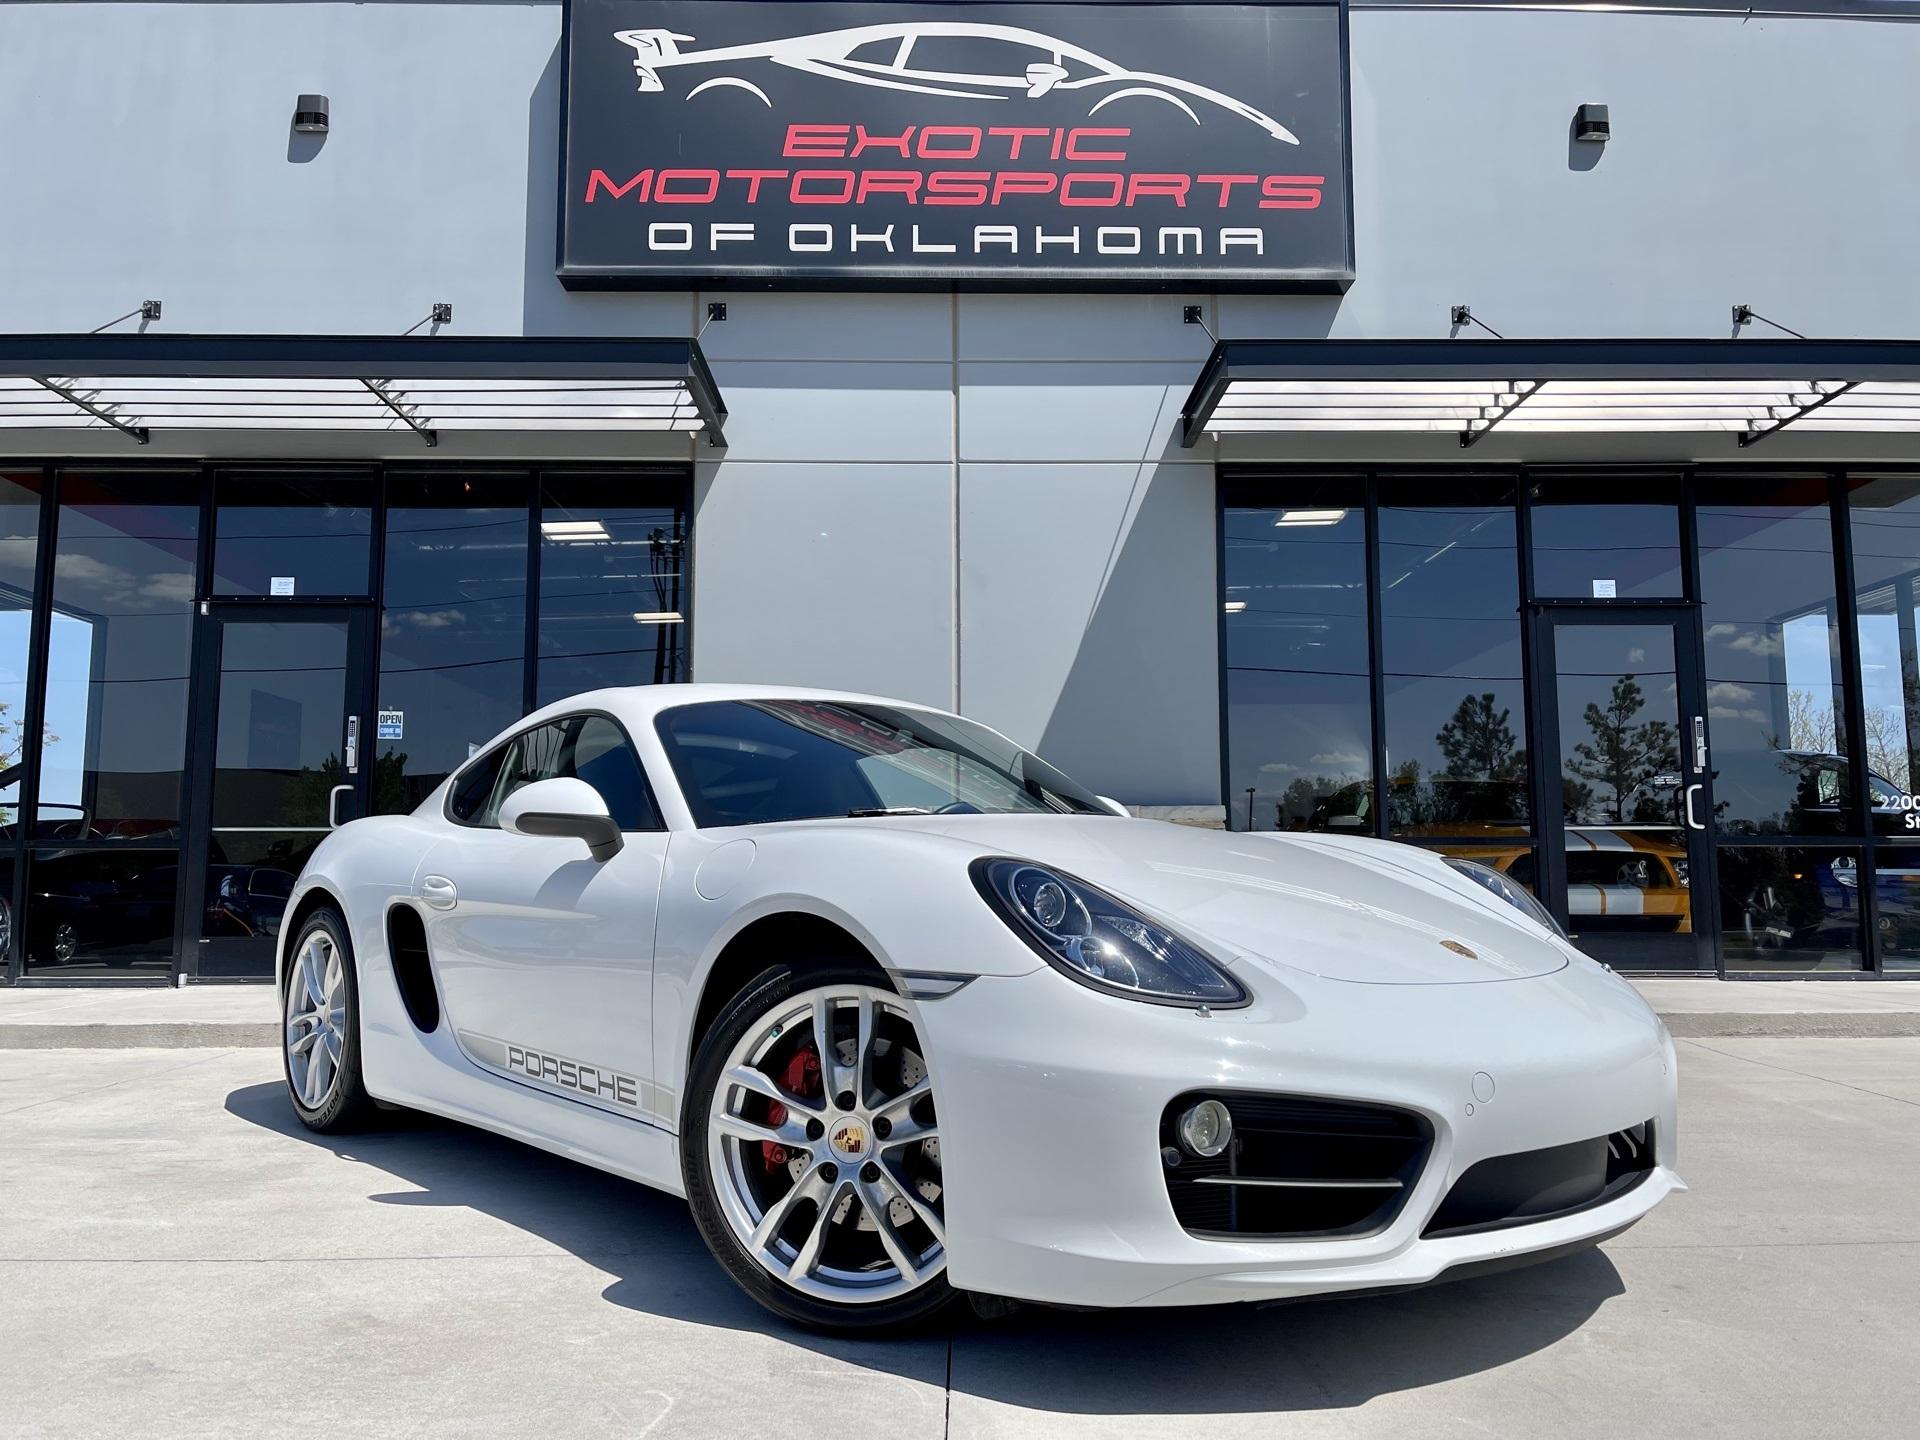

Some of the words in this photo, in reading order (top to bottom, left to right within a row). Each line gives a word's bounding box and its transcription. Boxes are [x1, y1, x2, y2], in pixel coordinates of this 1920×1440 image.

[784, 125, 1129, 160] EXOTIC
[586, 169, 1323, 208] MOTORSPORTS
[649, 223, 754, 250] OF
[789, 224, 1263, 254] OKLAHOMA
[380, 714, 402, 724] OPEN
[508, 1046, 638, 1106] PORSCHE
